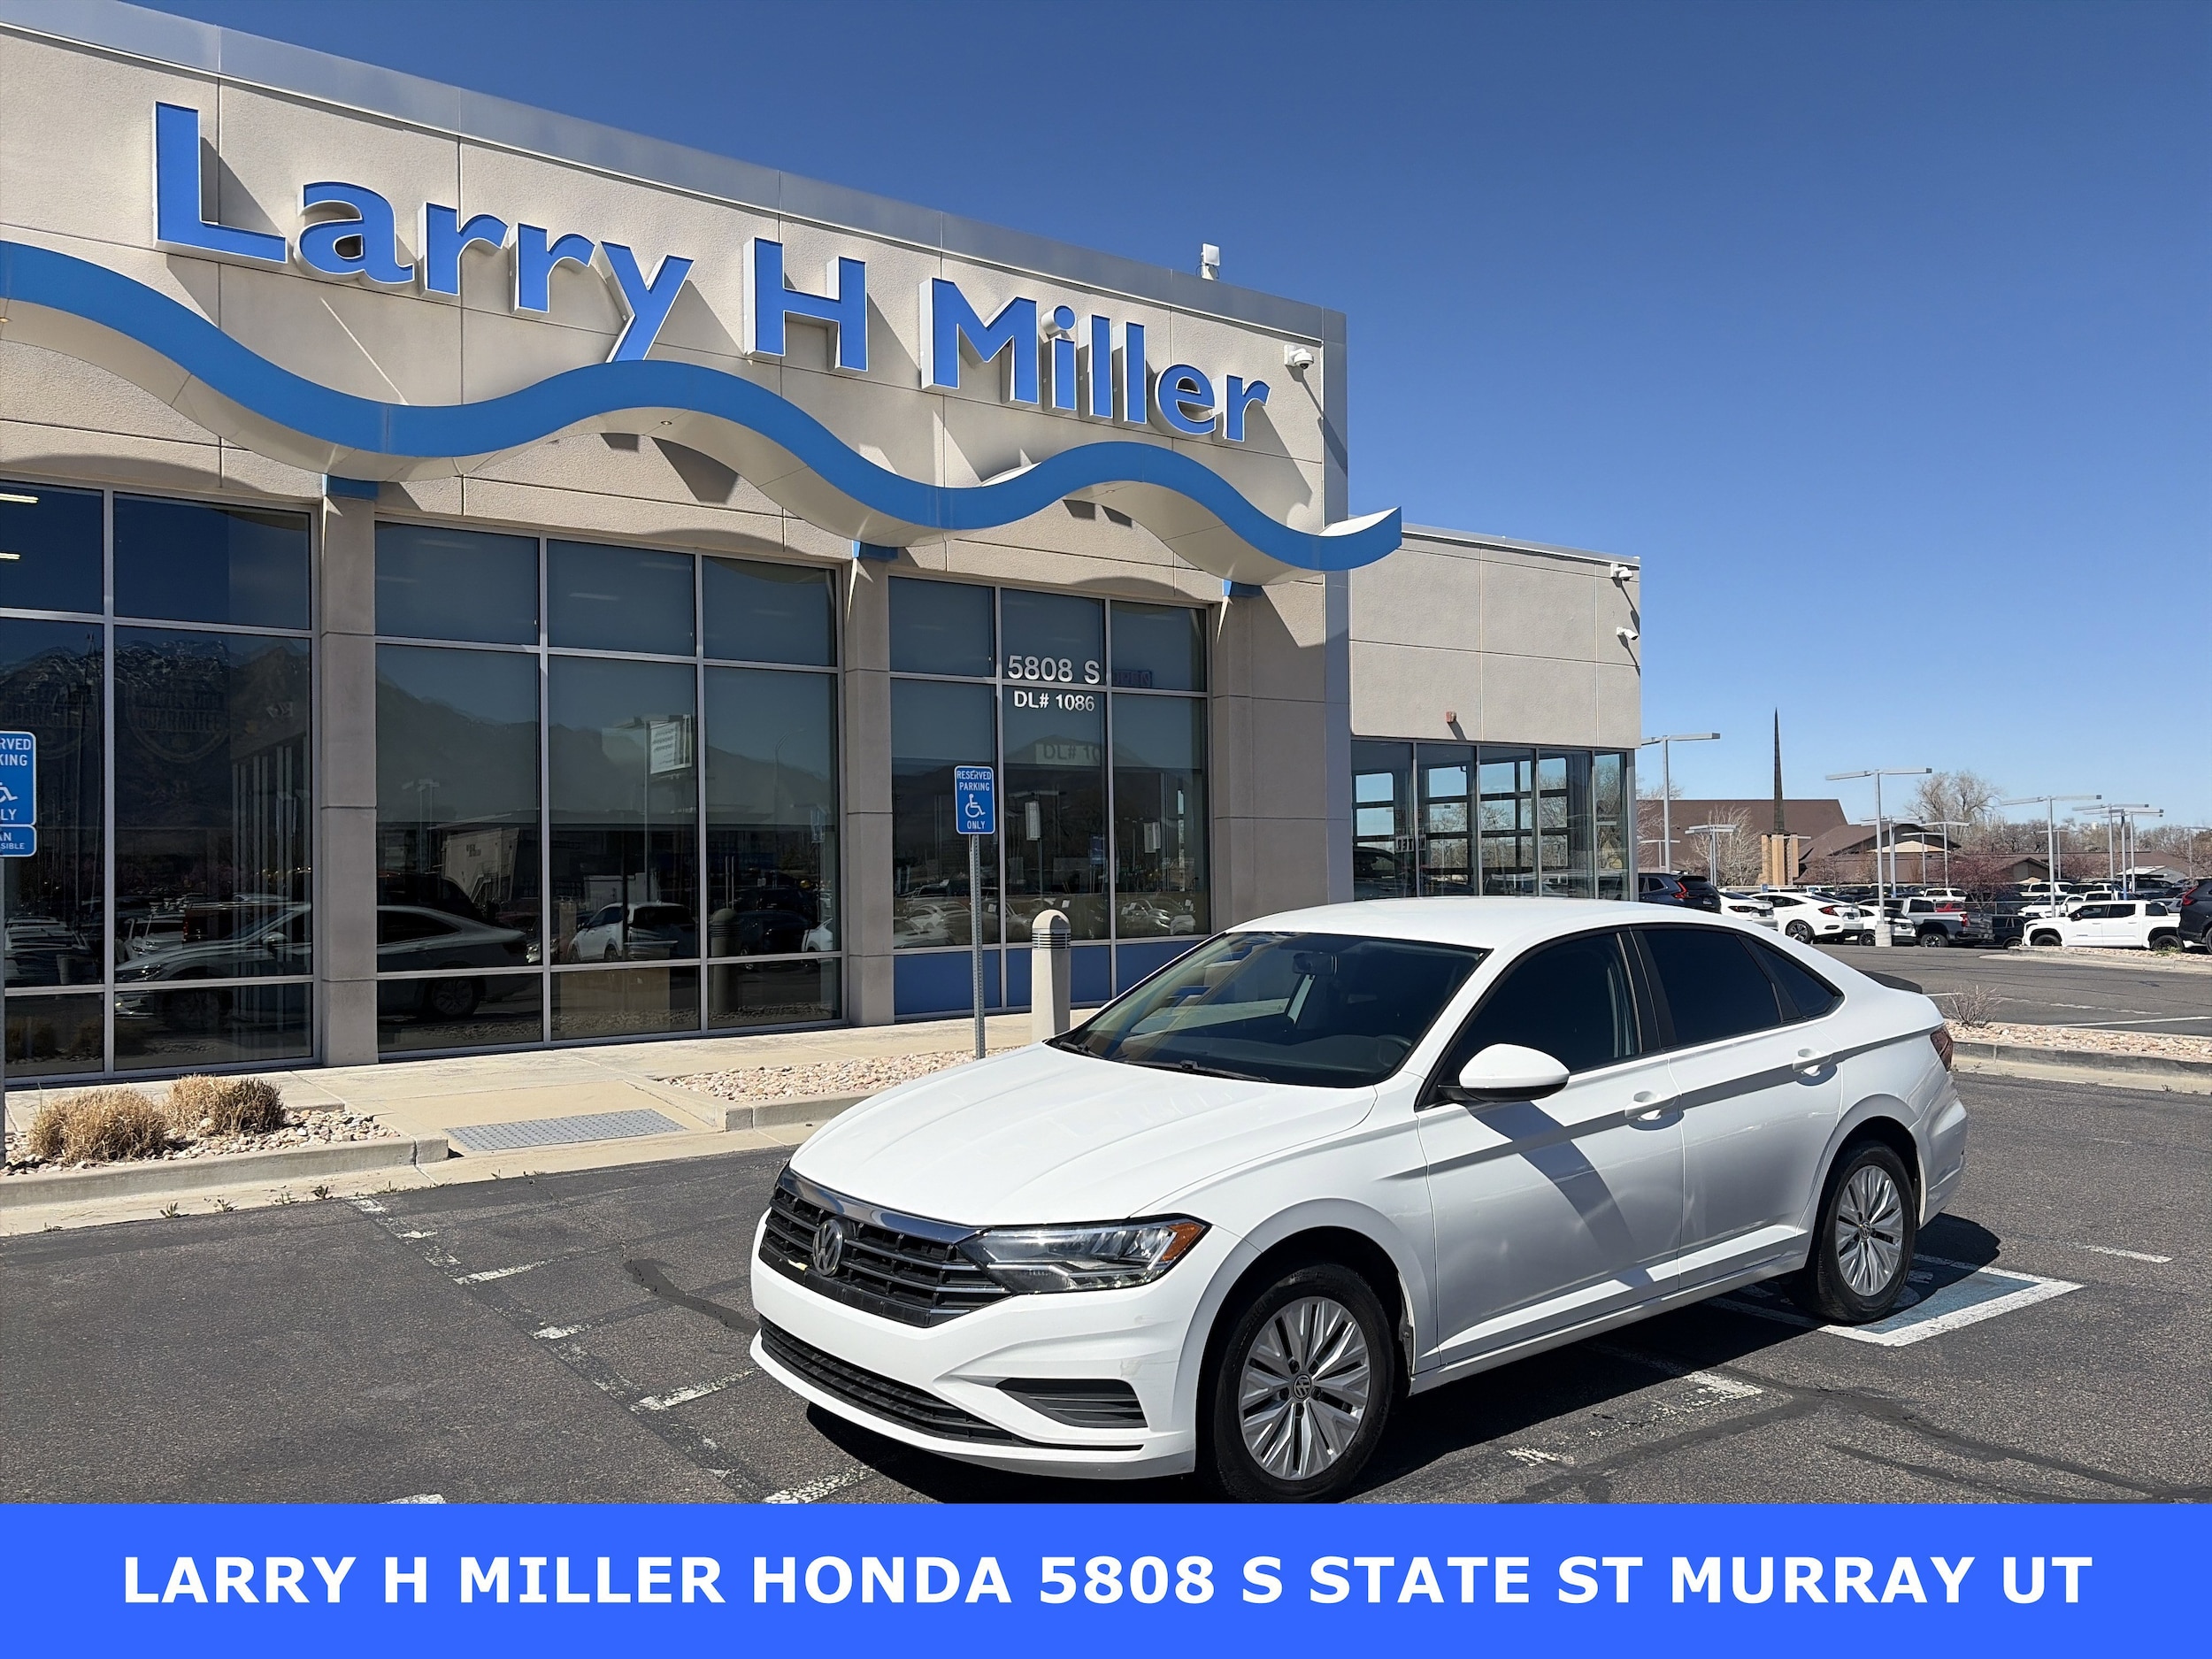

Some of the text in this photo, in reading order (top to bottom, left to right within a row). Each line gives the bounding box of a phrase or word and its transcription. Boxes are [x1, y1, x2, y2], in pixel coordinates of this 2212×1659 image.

[154, 101, 1270, 442] Larry H Miller
[1007, 655, 1101, 685] 5808 S
[1013, 689, 1095, 711] DL# 1086
[956, 770, 992, 780] RESERVED
[959, 781, 990, 792] PARKING
[966, 820, 986, 829] ONLY
